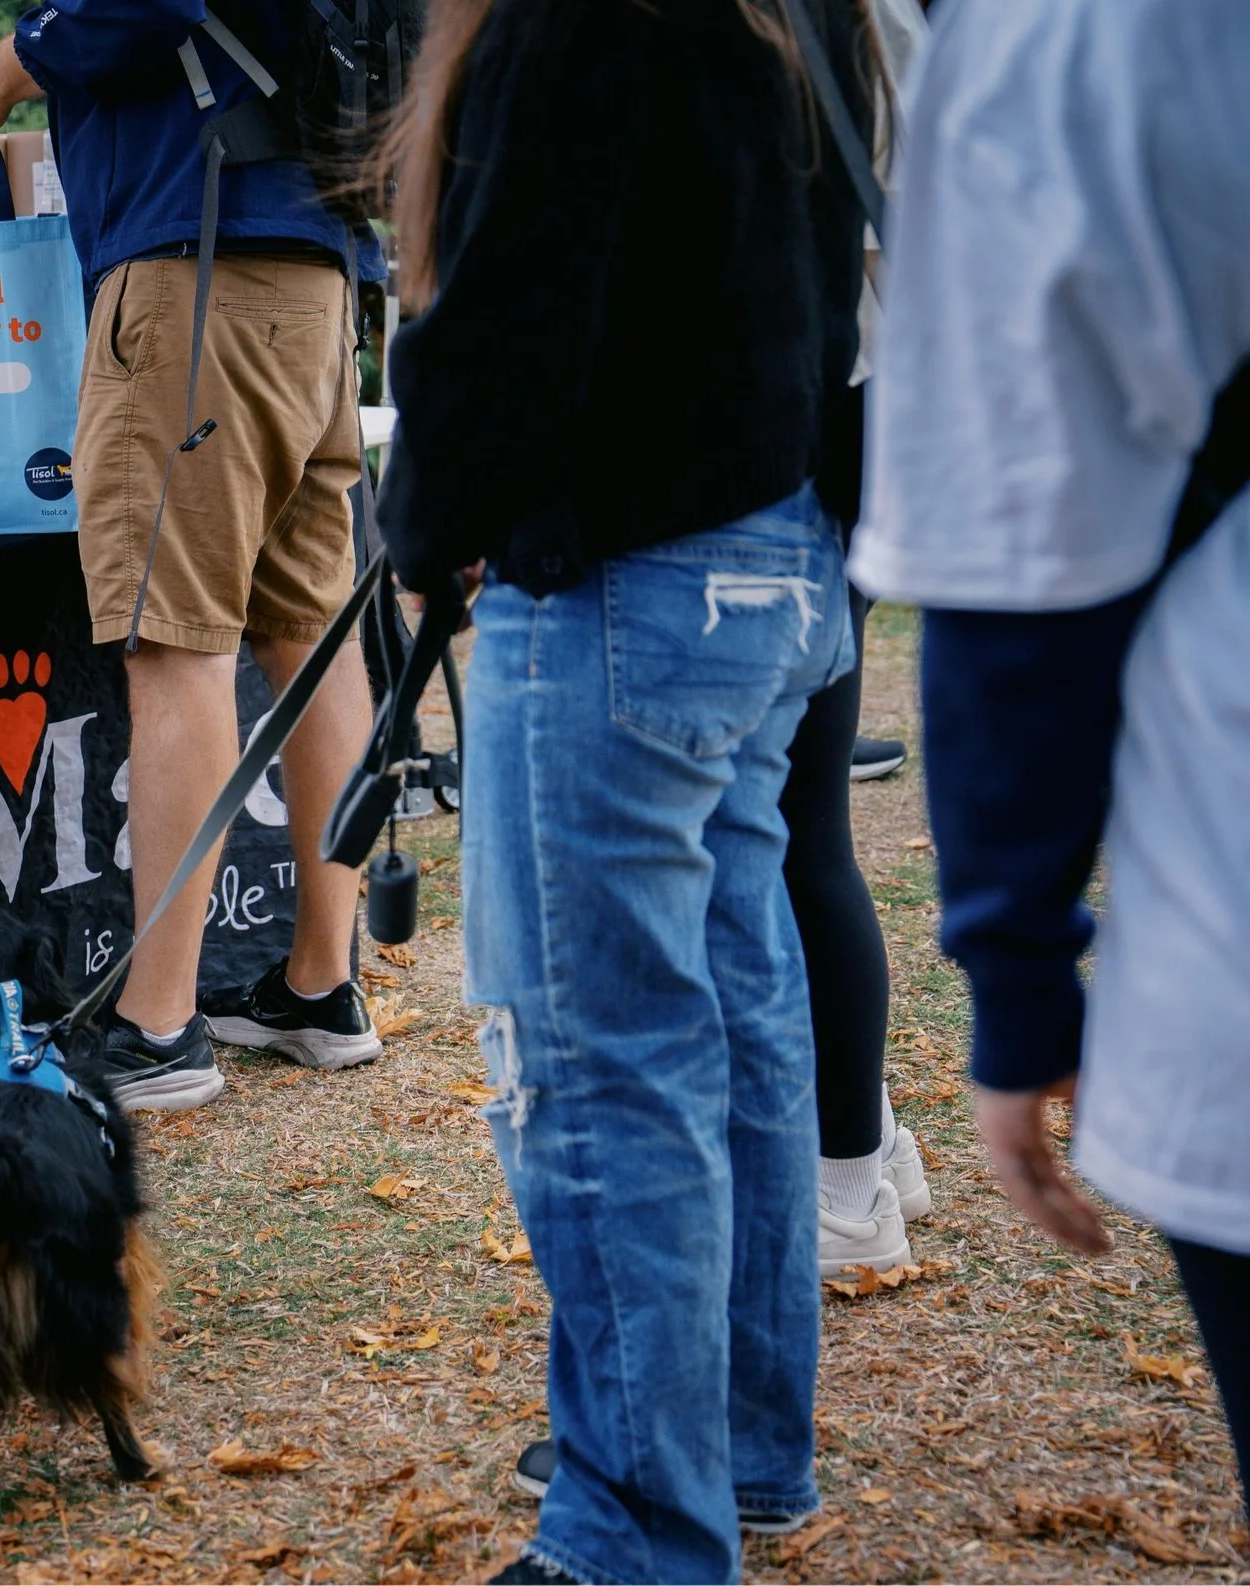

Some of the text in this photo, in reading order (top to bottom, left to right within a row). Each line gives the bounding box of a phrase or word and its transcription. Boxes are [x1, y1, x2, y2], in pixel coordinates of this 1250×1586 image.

[8, 317, 42, 342] to
[26, 466, 55, 479] Tisol
[41, 508, 68, 516] tisol.ca
